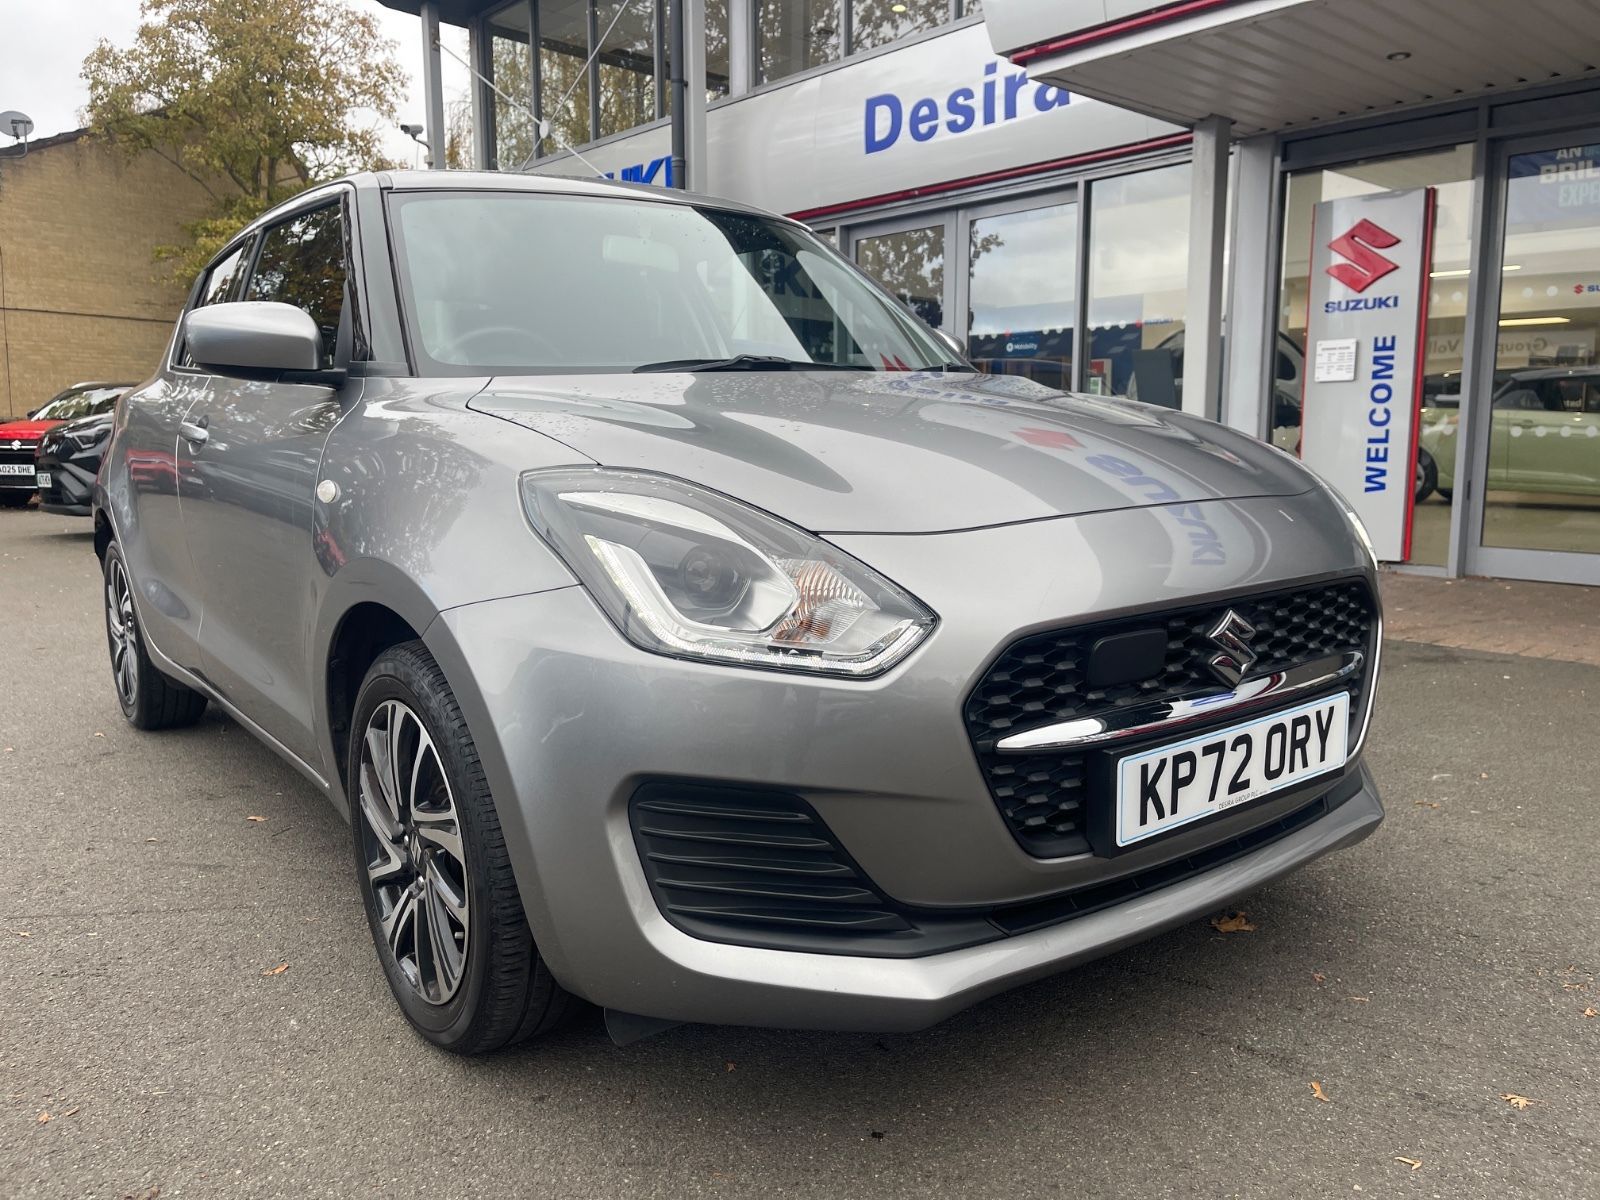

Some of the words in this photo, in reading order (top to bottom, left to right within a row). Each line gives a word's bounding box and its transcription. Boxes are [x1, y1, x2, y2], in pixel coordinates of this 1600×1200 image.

[865, 61, 1070, 154] Desira
[1324, 296, 1399, 313] SUZUKI
[1364, 335, 1396, 493] WELCOME
[1139, 733, 1253, 826] KP72
[1264, 706, 1335, 781] ORY
